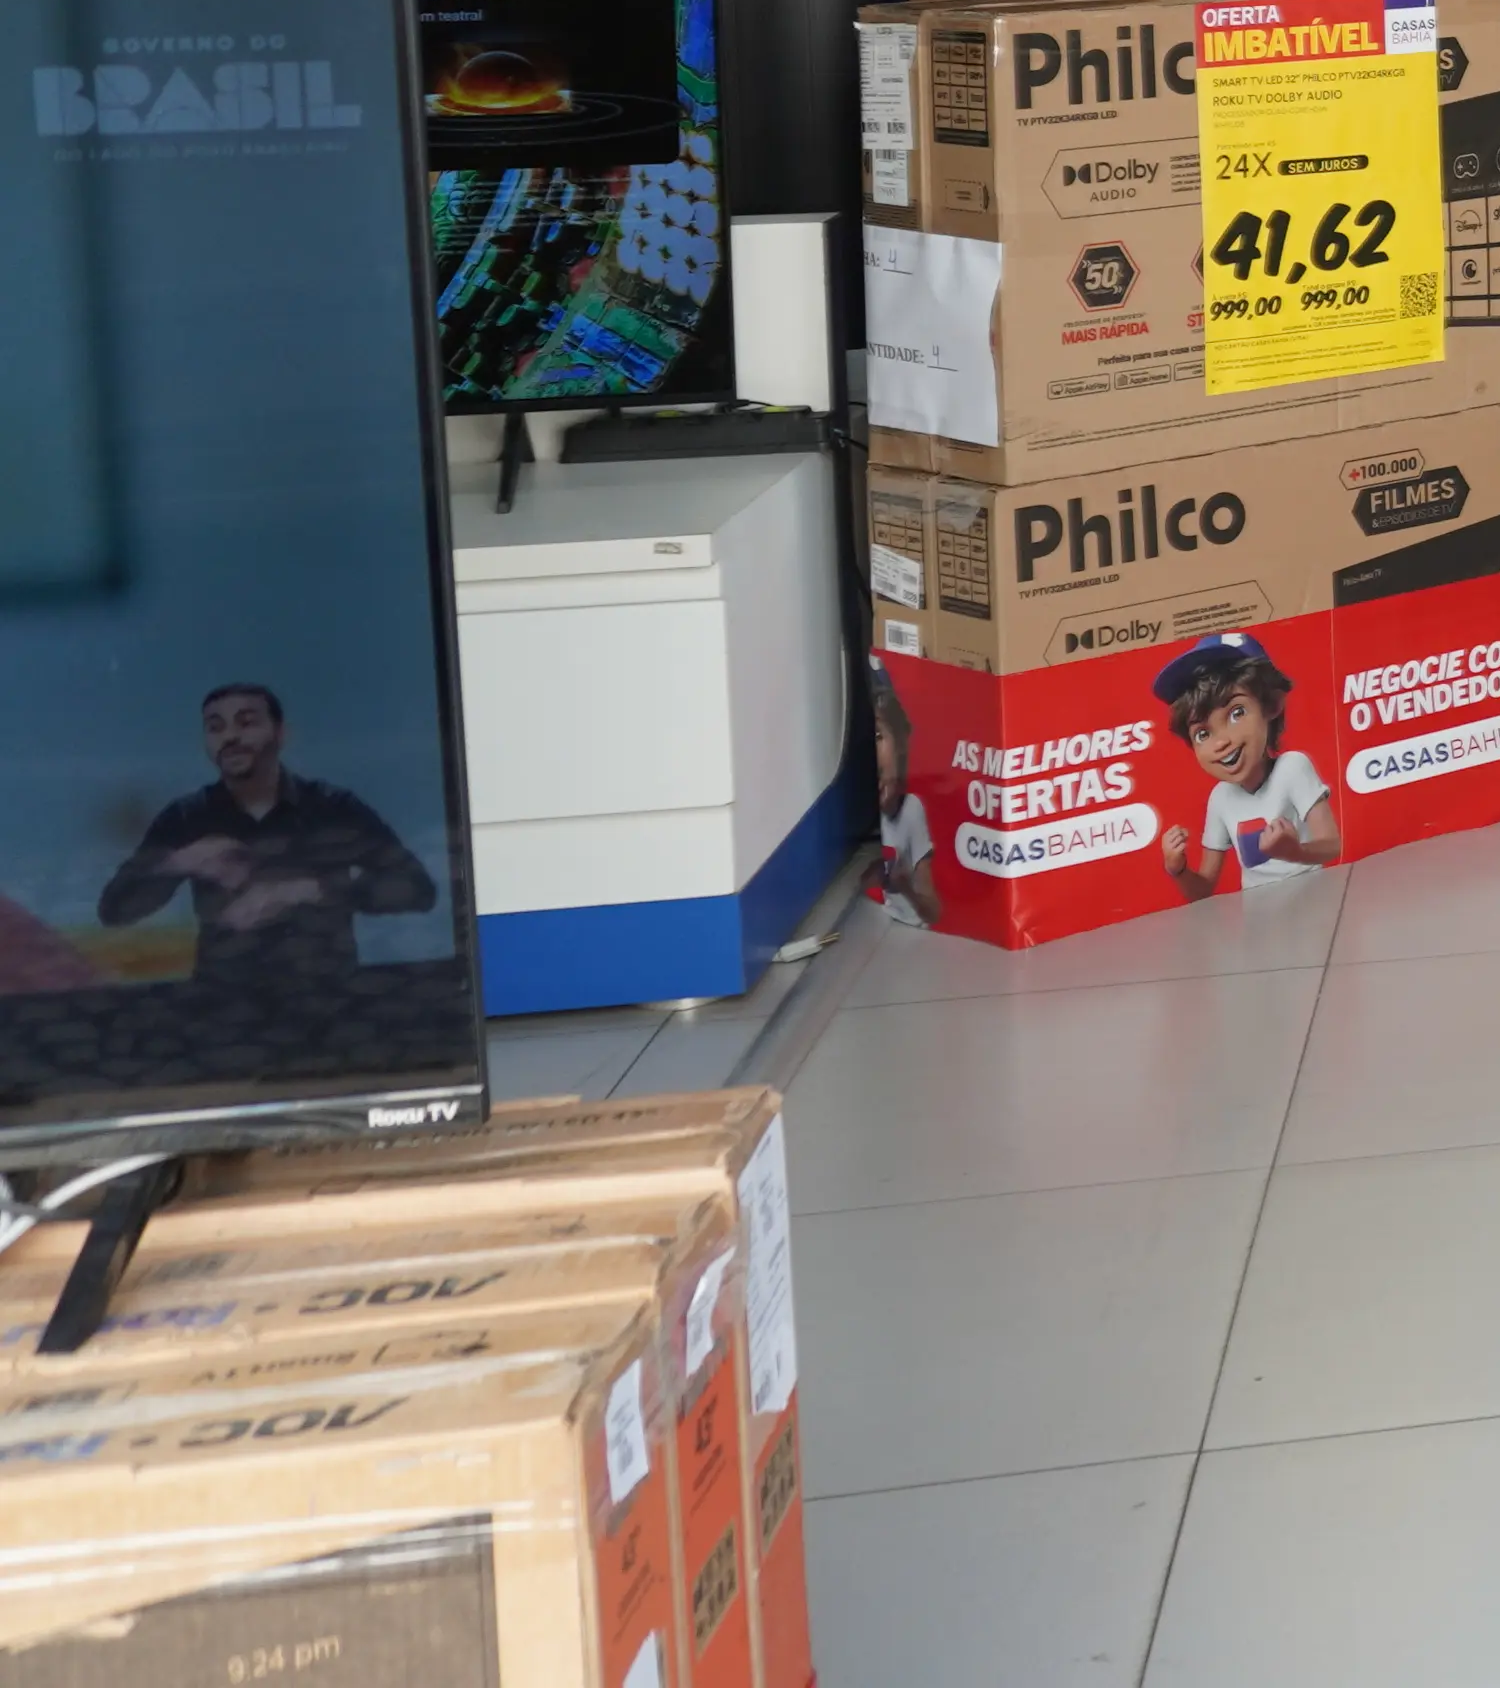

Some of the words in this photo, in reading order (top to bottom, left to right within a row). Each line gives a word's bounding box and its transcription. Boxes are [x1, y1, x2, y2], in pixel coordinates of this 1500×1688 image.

[32, 61, 361, 136] BRASIL
[1096, 157, 1159, 184] Dolby
[1089, 186, 1137, 203] AUDIO
[1210, 199, 1396, 284] 41,62
[1083, 262, 1122, 291] 50
[1061, 327, 1096, 346] MAIS
[1099, 316, 1149, 342] RÁPIDA
[1369, 478, 1456, 514] FILMES
[1014, 483, 1247, 583] Philco
[1343, 653, 1464, 704] NEGOCIE
[1350, 701, 1374, 731] O
[951, 740, 979, 772] AS
[982, 720, 1154, 780] MELHORES
[967, 761, 1132, 822] OFERTAS
[427, 1102, 459, 1122] TV
